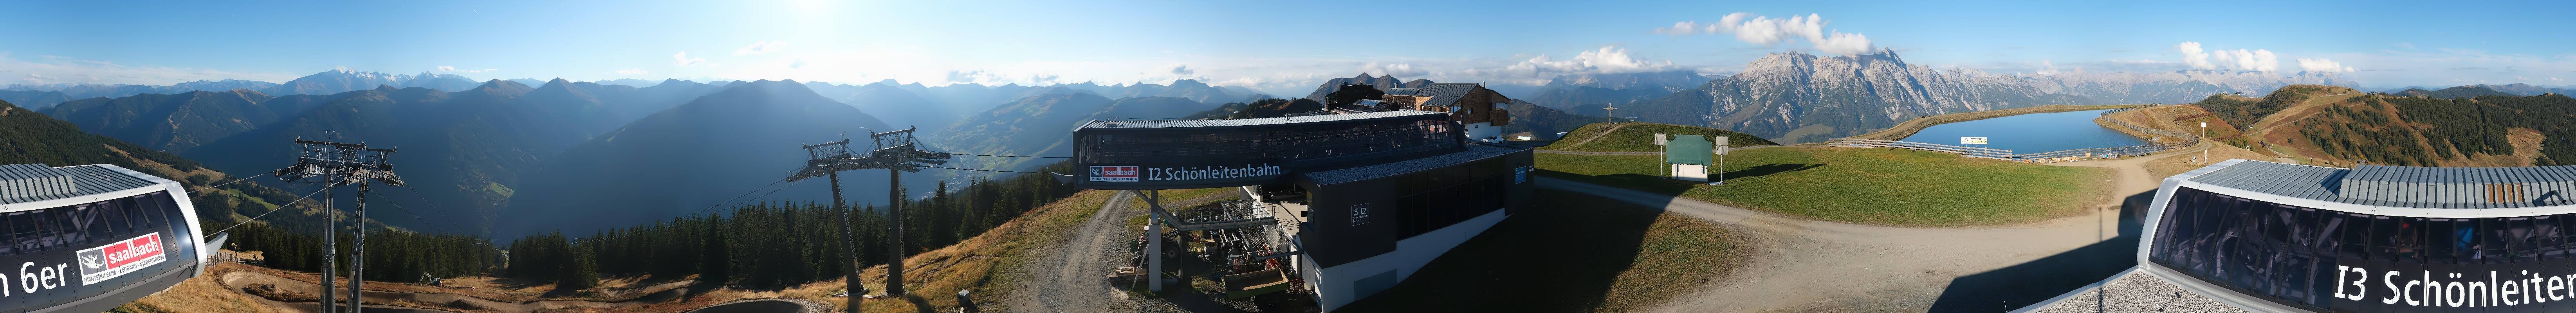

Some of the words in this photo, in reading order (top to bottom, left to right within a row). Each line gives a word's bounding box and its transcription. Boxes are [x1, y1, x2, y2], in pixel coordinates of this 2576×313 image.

[1105, 167, 1136, 176] saalbach
[1165, 162, 1280, 180] Schönleitenbahn
[109, 235, 159, 264] saalbach
[21, 261, 67, 293] 6er
[121, 263, 137, 273] LEOGANG
